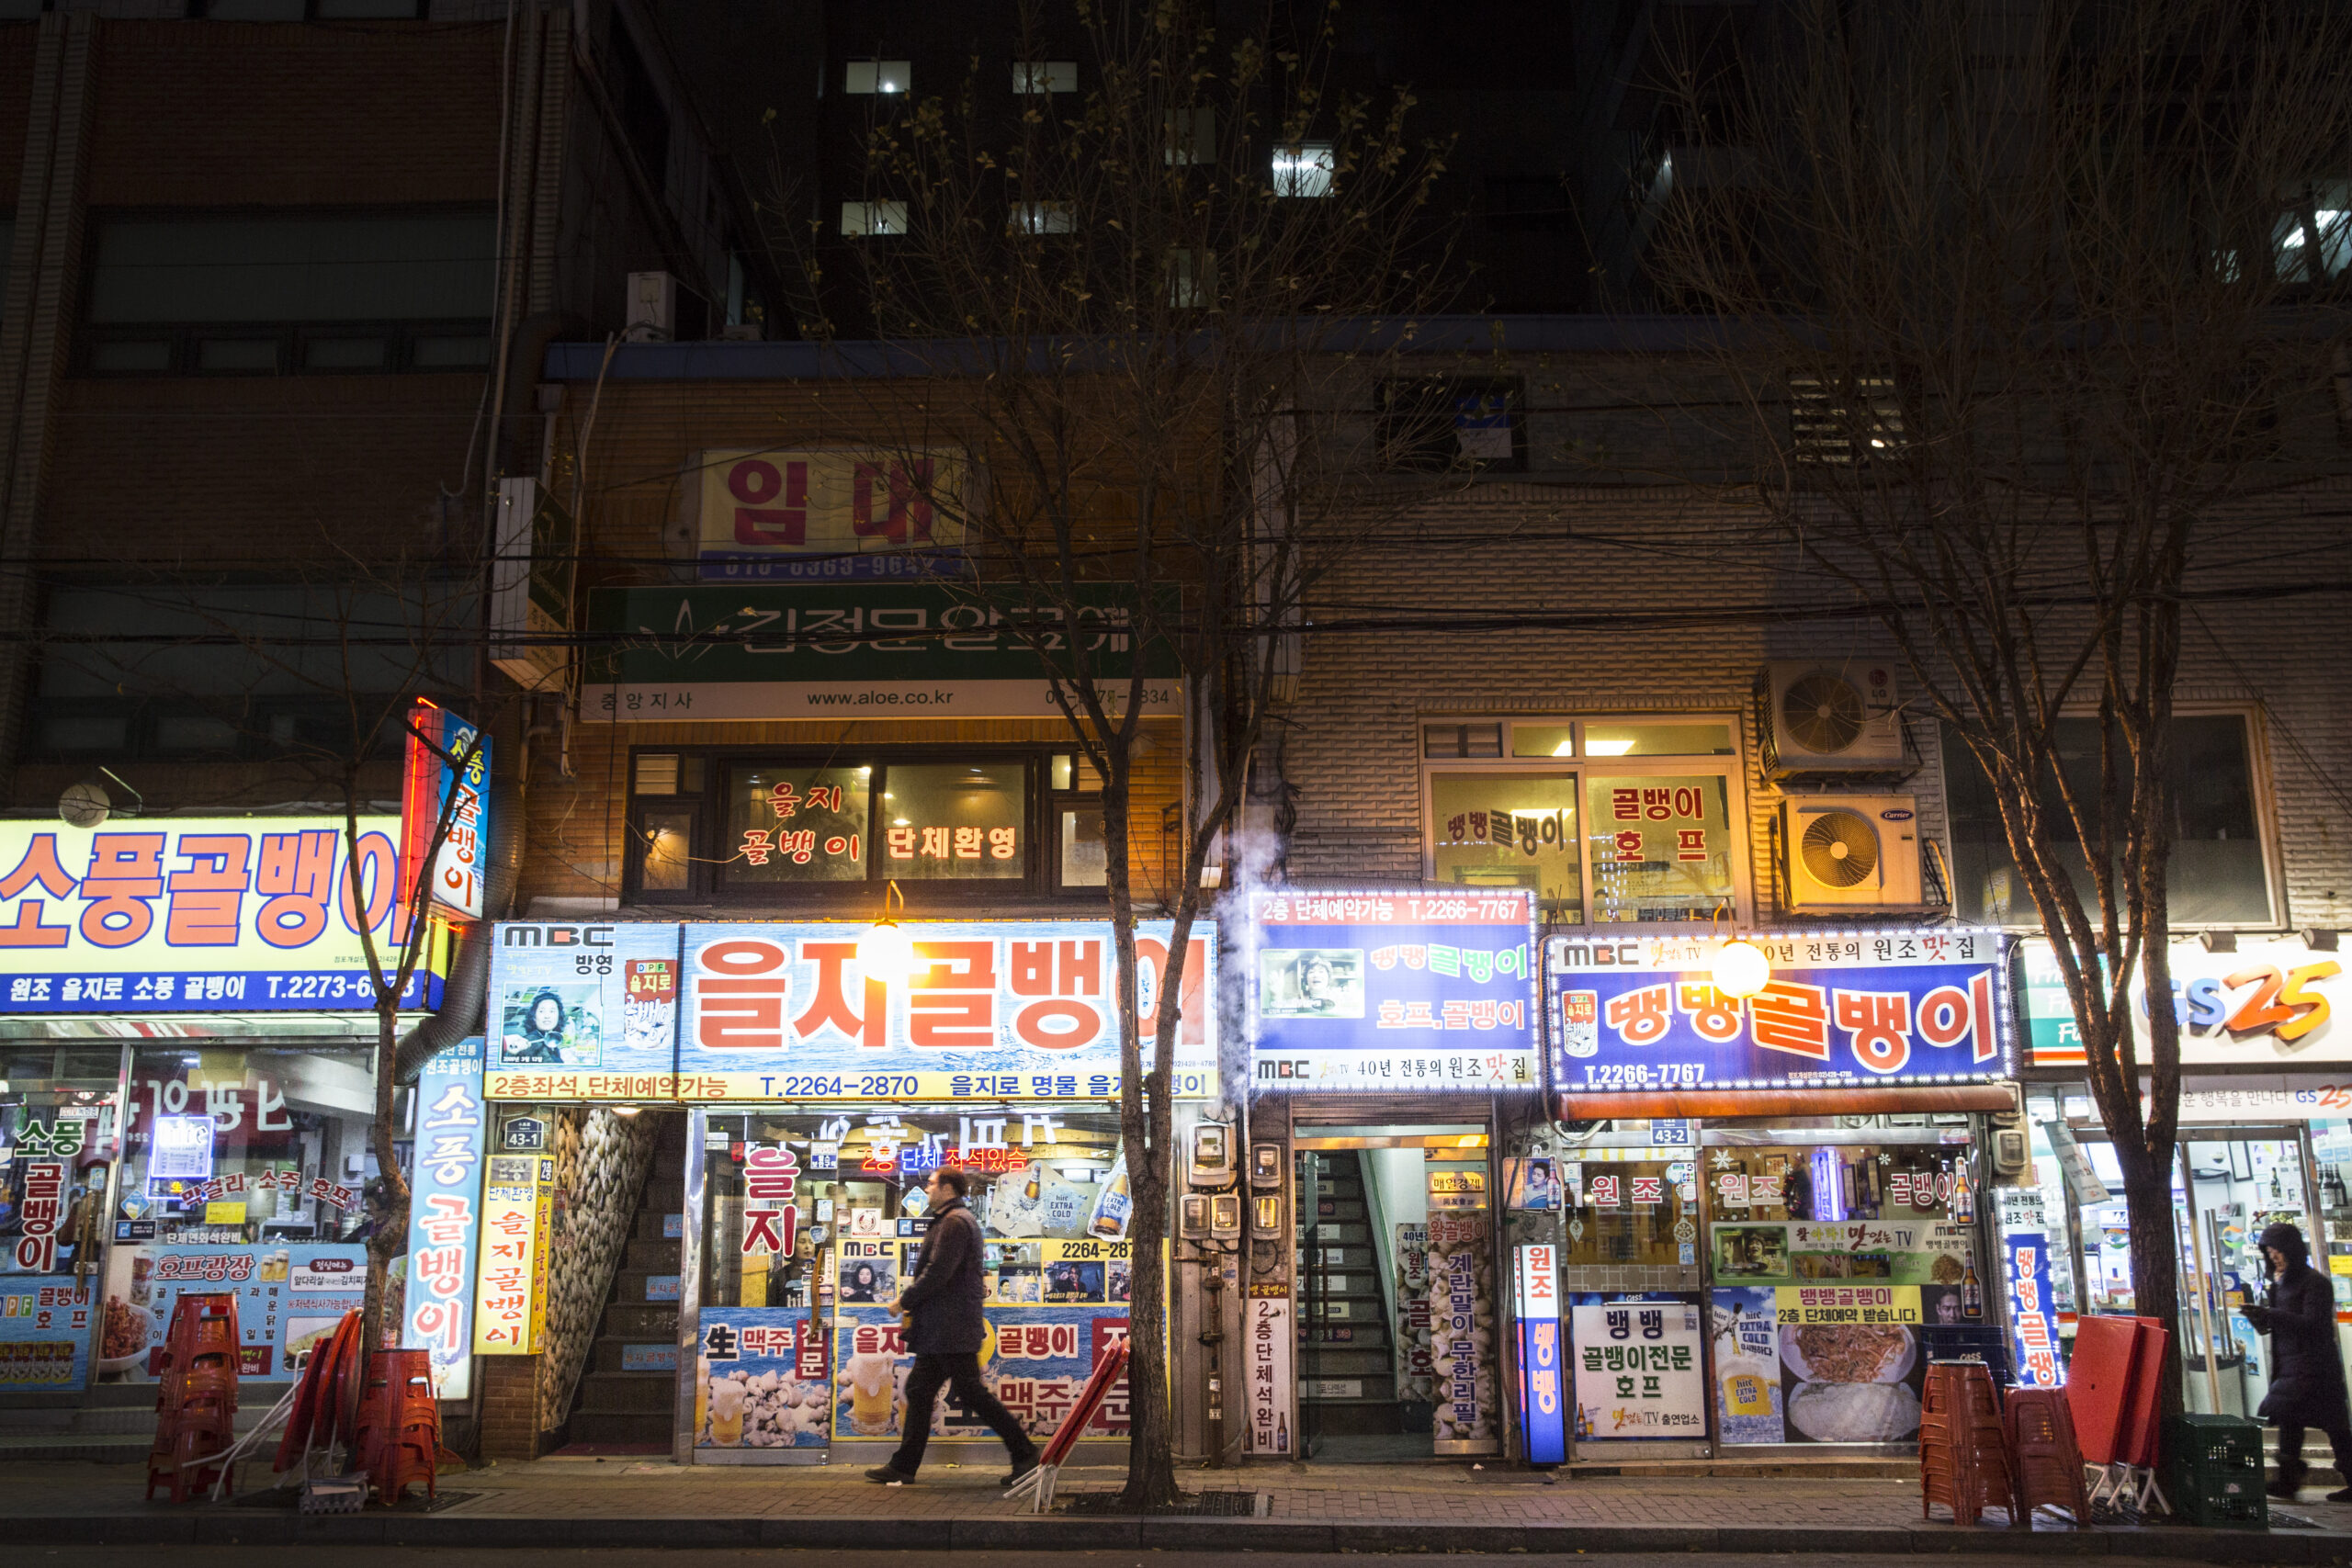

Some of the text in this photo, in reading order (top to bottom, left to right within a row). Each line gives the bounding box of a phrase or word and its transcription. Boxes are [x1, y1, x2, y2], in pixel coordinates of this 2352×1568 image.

[600, 691, 694, 710] 중앙지사
[807, 690, 954, 706] www.aloe.co.kr
[765, 781, 843, 818] 을지
[1612, 787, 1703, 820] 골뱅이
[1883, 810, 1911, 820] Carrier
[887, 826, 1016, 860] 단체환영
[1447, 807, 1565, 857] 뱅뱅골뱅이
[444, 782, 483, 910] 골뱅이
[739, 829, 860, 865] 골뱅이
[1614, 829, 1707, 863] 호프
[0, 829, 415, 949] 소풍골뱅이
[1262, 897, 1520, 921] 2층 단체예약가능 T.2266-7767
[503, 926, 615, 947] MBC
[574, 954, 614, 976] 방영
[1370, 943, 1528, 984] 뱅뱅골뱅이
[1564, 943, 1640, 966] MBC
[1685, 946, 1702, 960] TV
[1757, 942, 1794, 962] 0년
[1806, 942, 1860, 962] 전통의
[9, 977, 52, 1003] 원조
[61, 976, 125, 1002] 을지로
[131, 976, 175, 1001] 소풍
[184, 976, 246, 1001] 골뱅이
[628, 974, 672, 993] 을지로
[695, 938, 1207, 1051] 을지골뱅이
[2142, 960, 2343, 1041] GS25
[1376, 999, 1525, 1031] 호프.골뱅이
[1604, 968, 1997, 1074] 뱅뱅골뱅이
[458, 1043, 477, 1056] 전통
[426, 1057, 483, 1076] 원조골뱅이
[1258, 1059, 1310, 1079] MBC
[1357, 1059, 1392, 1077] 40년
[1399, 1059, 1442, 1078] 전통의
[1584, 1064, 1705, 1084] T.2266-7767
[761, 1076, 919, 1097] T.2264-2870
[949, 1075, 1022, 1097] 을지로
[1031, 1075, 1079, 1097] 명물
[2199, 1089, 2243, 1108] 행복을
[2246, 1089, 2290, 1107] 만나다
[2295, 1084, 2352, 1110] GS25
[15, 1120, 85, 1157] 소풍
[423, 1082, 481, 1186] 소풍
[508, 1133, 538, 1146] 43-1
[1655, 1129, 1686, 1142] 43-2
[540, 1161, 553, 1181] 2층
[900, 1146, 941, 1172] 단체
[181, 1169, 353, 1211] 막걸리, 소주, 호프
[489, 1186, 534, 1201] 단체환영
[1433, 1179, 1481, 1190] 매일경제
[1590, 1176, 1663, 1207] 원조
[1718, 1174, 1784, 1208] 원조
[1890, 1172, 1954, 1206] 골뱅이
[741, 1147, 801, 1259] 을지
[1050, 1201, 1074, 1210] EXTRA
[1052, 1210, 1071, 1218] COLD
[16, 1162, 63, 1273] 골뱅이
[166, 1232, 242, 1245] 단체연회석완비
[1430, 1220, 1487, 1242] 왕골뱅이
[1847, 1224, 1893, 1252] 맛있는
[1894, 1230, 1912, 1247] TV
[1935, 1225, 1967, 1236] MBC
[843, 1241, 894, 1257] MBC
[154, 1252, 256, 1281] 호프광장
[315, 1260, 348, 1270] 점심메뉴
[413, 1193, 473, 1355] 골뱅이
[1529, 1247, 1553, 1299] 원조
[484, 1209, 535, 1348] 을지골뱅이
[1261, 1284, 1288, 1295] 골뱅이
[39, 1287, 90, 1306] 골뱅이
[1448, 1253, 1475, 1334] 계란말이
[1799, 1288, 1893, 1306] 뱅뱅골뱅이
[35, 1310, 88, 1329] 호프
[1605, 1309, 1664, 1340] 뱅뱅
[1713, 1311, 1727, 1321] hite
[1739, 1320, 1772, 1332] EXTRA
[1746, 1311, 1762, 1320] hite
[1778, 1307, 1917, 1323] 2층 단체예약 받습니다
[707, 1326, 793, 1359] 生 맥주
[999, 1326, 1075, 1356] 골뱅이
[1742, 1332, 1770, 1345] COLD
[1532, 1323, 1557, 1415] 뱅뱅
[1582, 1346, 1693, 1372] 골뱅이전문
[1450, 1341, 1477, 1423] 무한리필
[1615, 1375, 1663, 1399] 호프
[1735, 1387, 1758, 1396] EXTRA
[1736, 1378, 1753, 1388] hite
[1000, 1382, 1072, 1421] 맥주
[1738, 1395, 1758, 1404] COLD
[1644, 1411, 1660, 1425] TV
[1661, 1413, 1700, 1425] 출연업소
